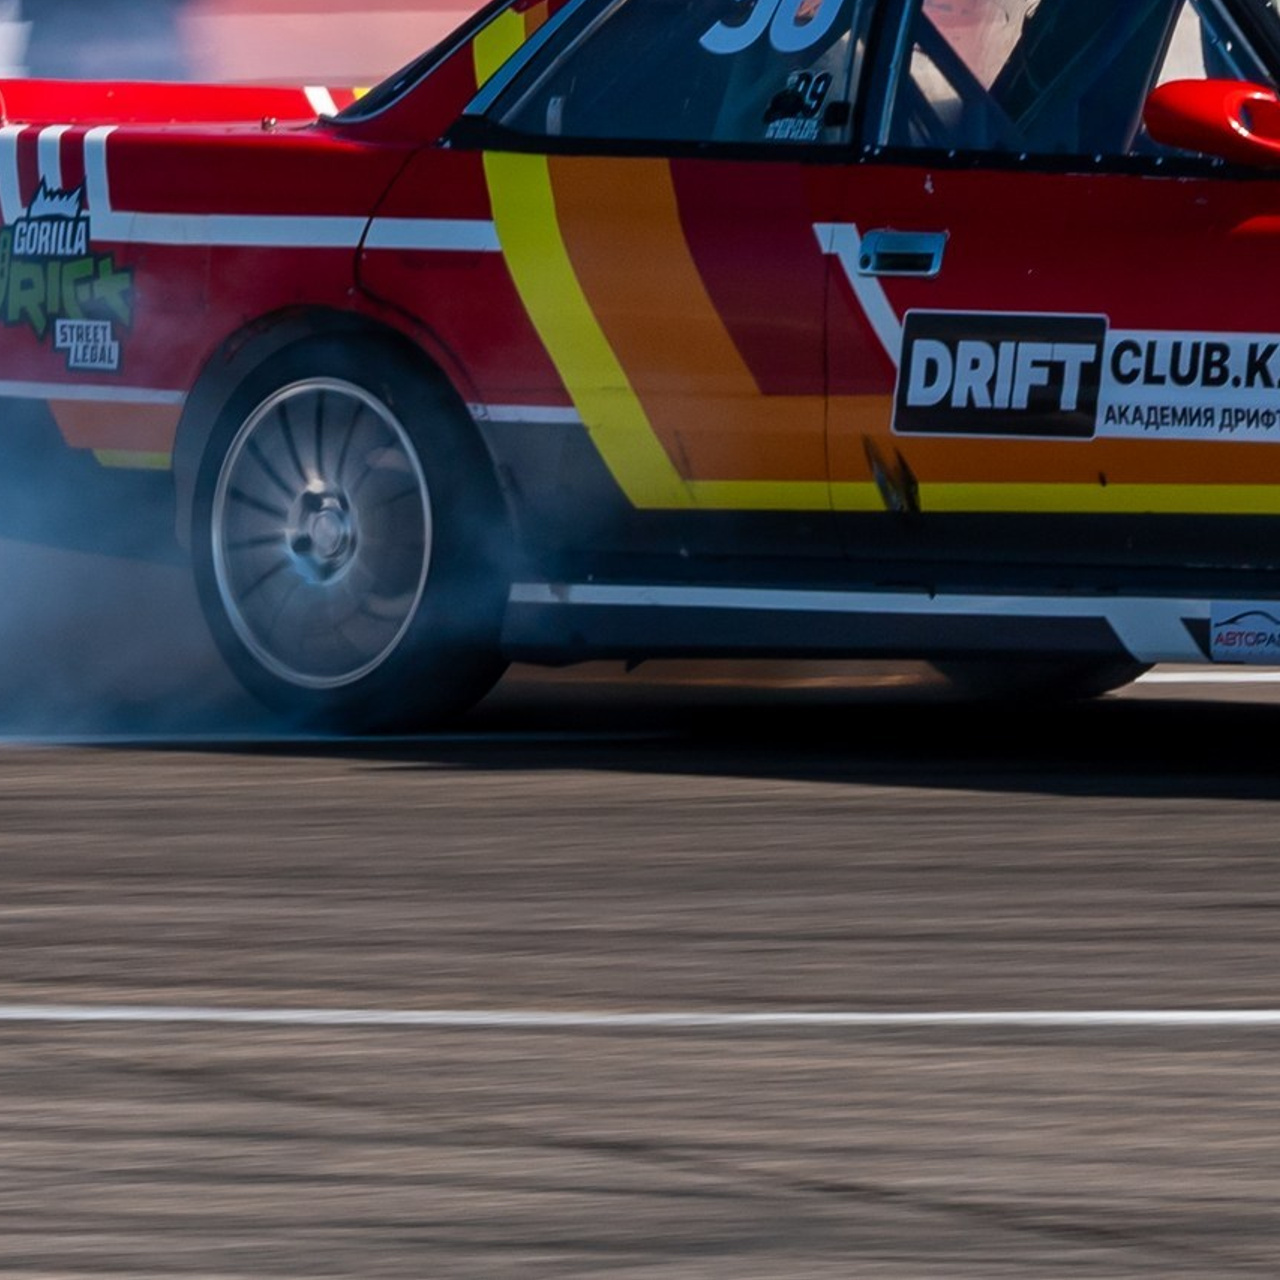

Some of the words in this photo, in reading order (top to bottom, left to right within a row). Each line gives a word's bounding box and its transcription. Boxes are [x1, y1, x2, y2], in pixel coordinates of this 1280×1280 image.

[13, 221, 87, 255] GORILLA
[59, 324, 109, 343] STREET
[72, 344, 115, 365] LEGAL
[906, 338, 1097, 410] DRIFT
[1104, 404, 1215, 430] АКАДЕМИЯ
